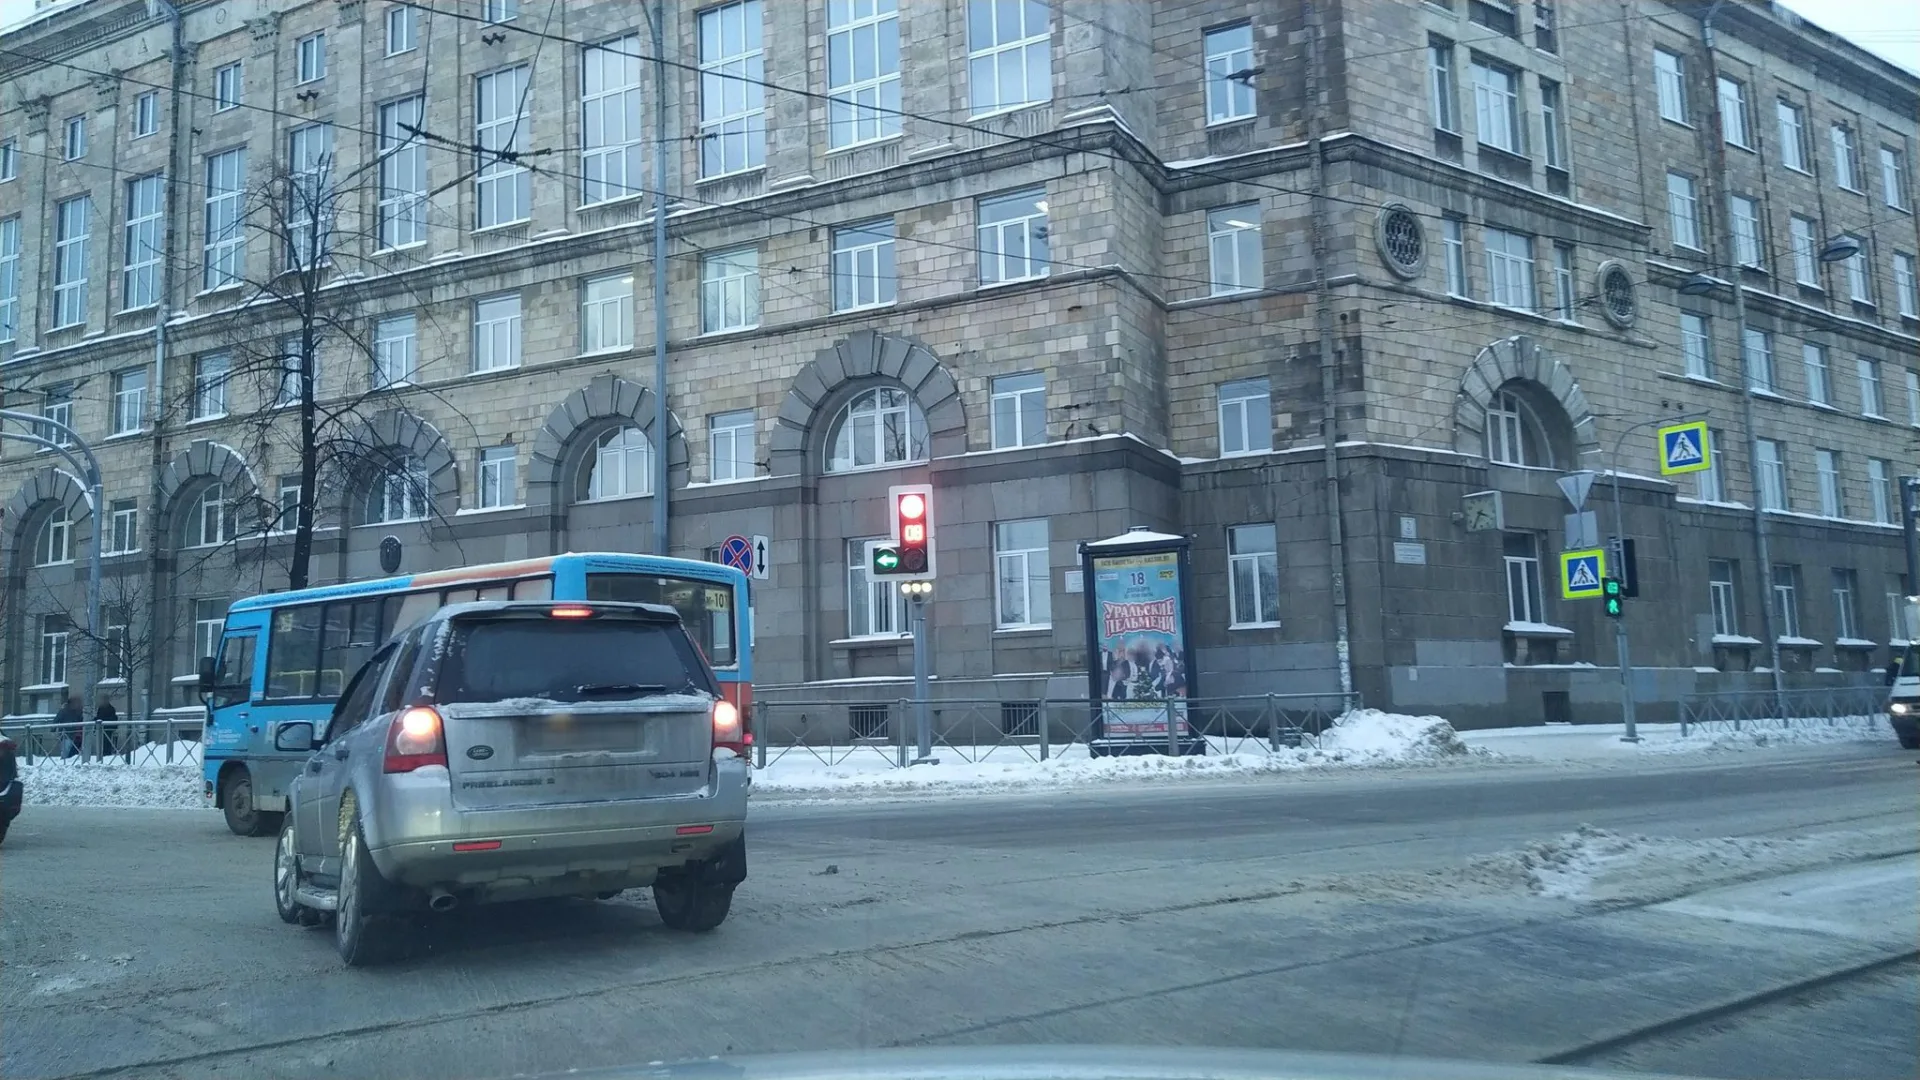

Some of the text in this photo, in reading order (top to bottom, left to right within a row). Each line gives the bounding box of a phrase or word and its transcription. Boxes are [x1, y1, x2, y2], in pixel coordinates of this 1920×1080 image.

[1130, 572, 1145, 586] 18
[1103, 599, 1175, 619] УРАЛЬСКИЕ
[1105, 615, 1176, 635] ПЕЛЬМЕНИ
[462, 779, 542, 790] FREELANDER
